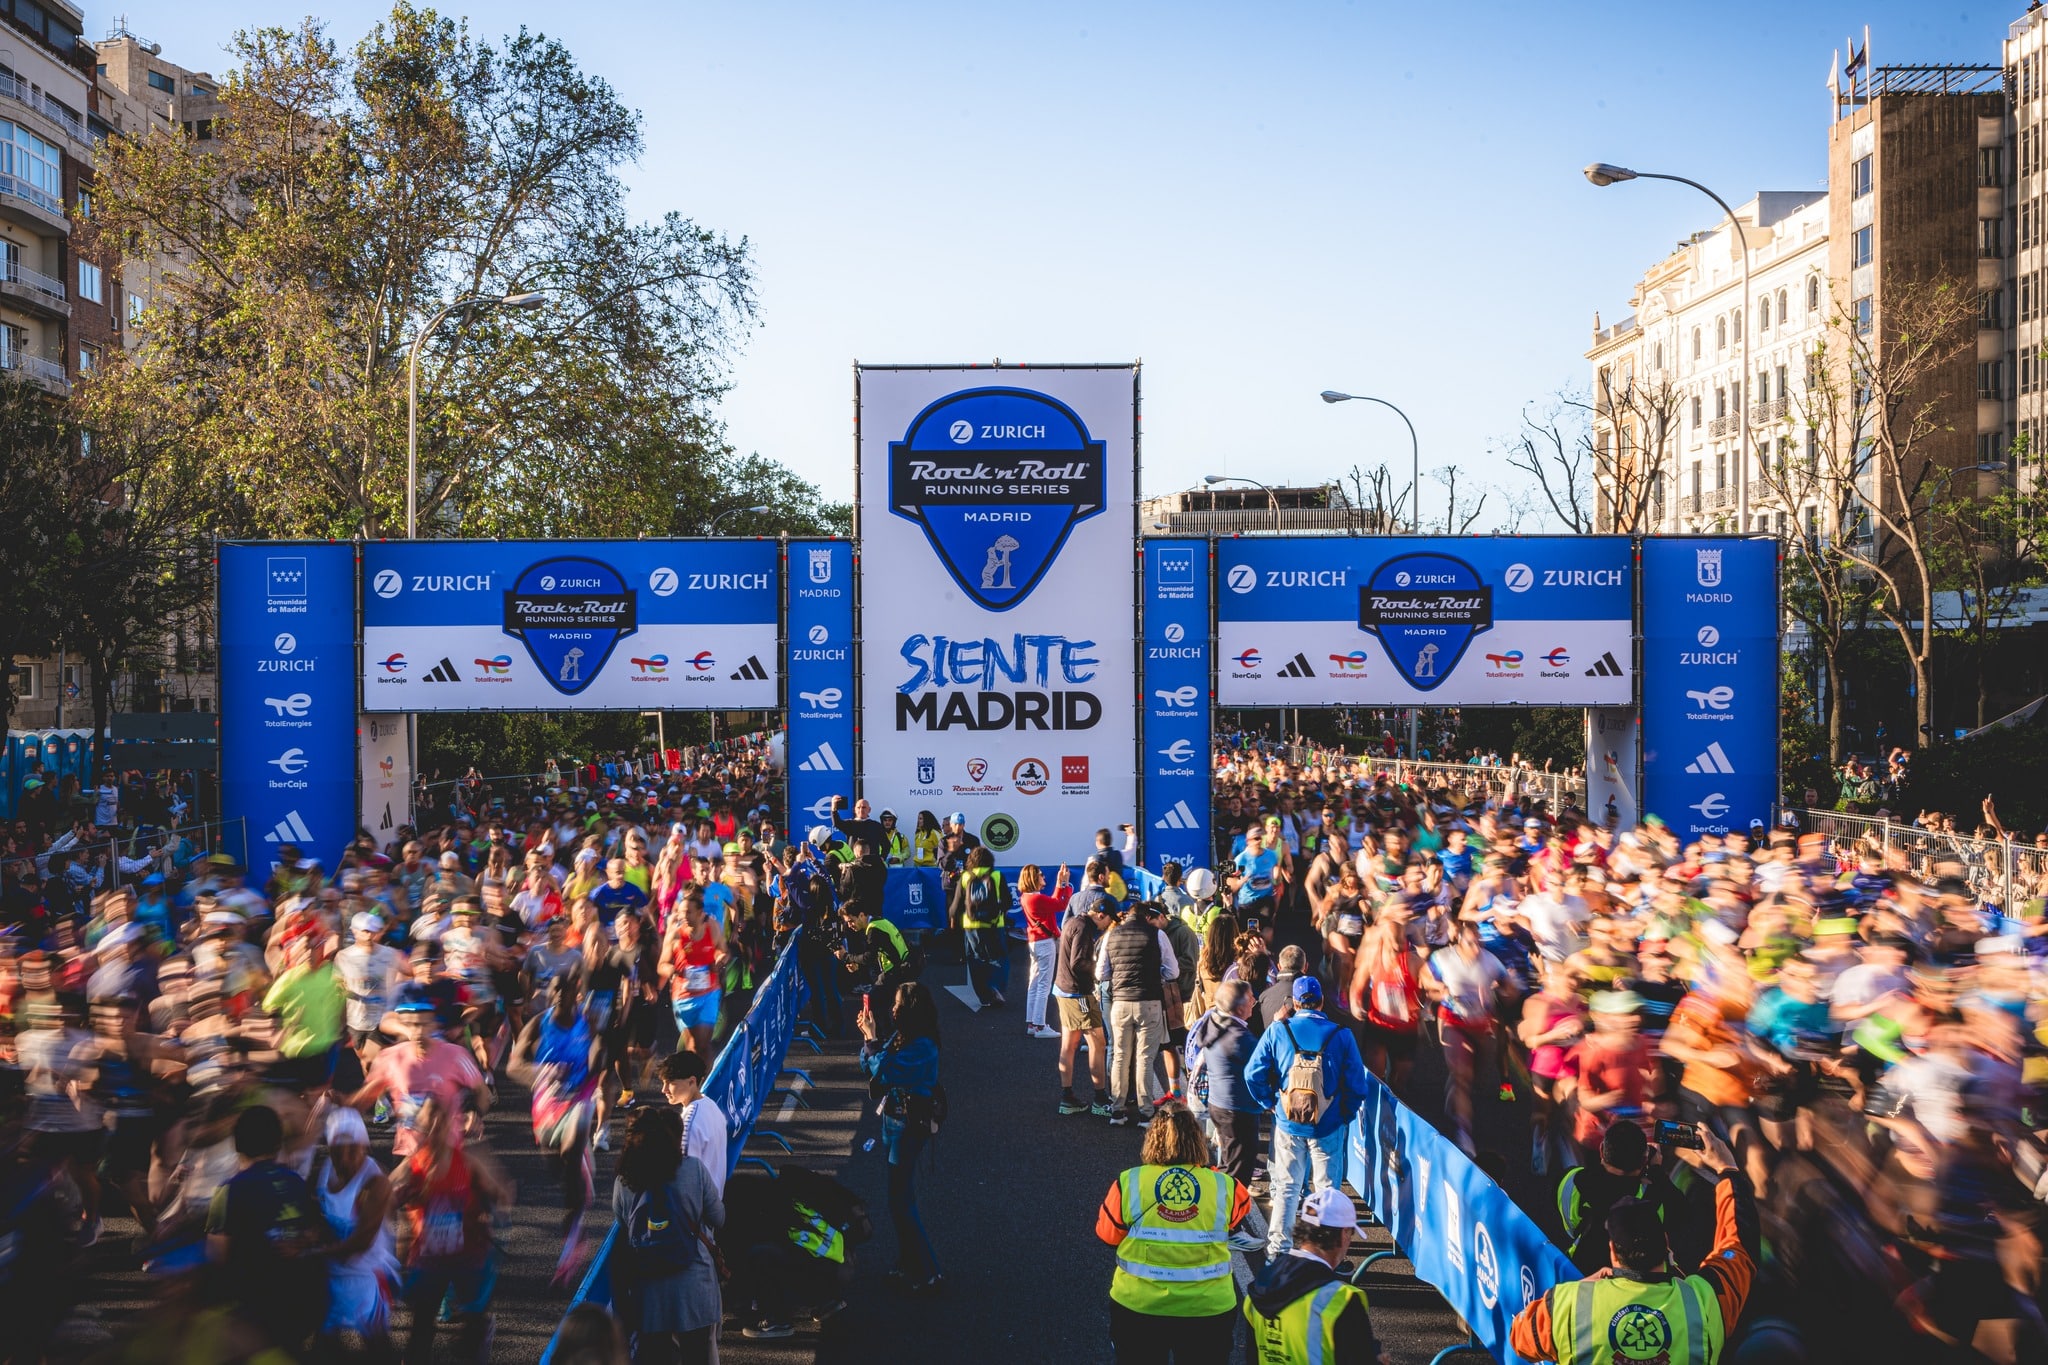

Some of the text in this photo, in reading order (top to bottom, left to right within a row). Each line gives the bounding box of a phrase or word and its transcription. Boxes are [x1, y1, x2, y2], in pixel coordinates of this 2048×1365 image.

[982, 425, 1046, 438] ZURICH
[926, 485, 1070, 495] RUNNING SERIES
[964, 513, 1031, 522] MADRID
[689, 574, 768, 590] ZURICH
[1267, 571, 1346, 587] ZURICH
[1415, 575, 1456, 584] ZURICH
[1544, 570, 1622, 586] ZURICH
[412, 576, 490, 591] ZURICH
[560, 579, 600, 588] ZURICH
[800, 590, 841, 598] MADRID
[1687, 594, 1732, 603] MADRID
[793, 650, 845, 660] ZURICH
[1149, 648, 1201, 659] ZURICH
[1680, 653, 1737, 664] ZURICH
[258, 660, 315, 672] ZURICH
[896, 633, 1100, 694] SIENTE
[896, 691, 1102, 731] MADRID
[265, 720, 312, 728] TotalEnergies
[1159, 768, 1194, 777] iberCaja
[269, 780, 308, 789] iberCaja
[1691, 825, 1729, 834] iberCaja
[1611, 1307, 1629, 1326] ciudad
